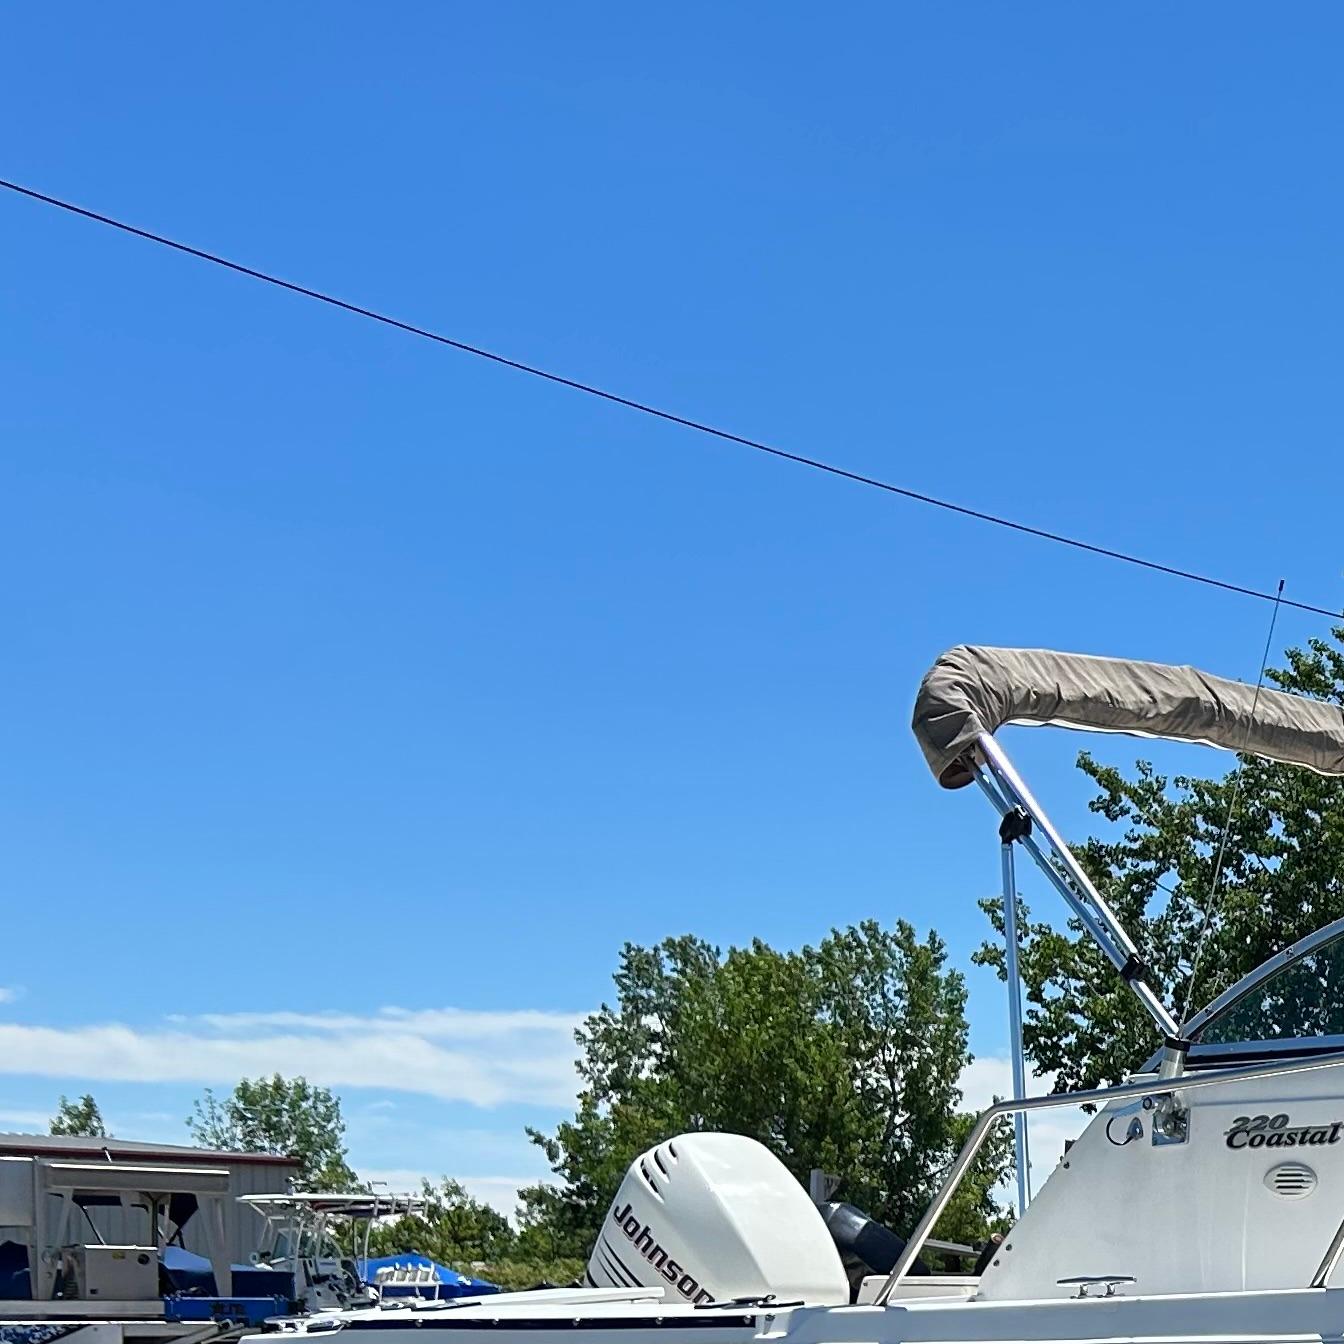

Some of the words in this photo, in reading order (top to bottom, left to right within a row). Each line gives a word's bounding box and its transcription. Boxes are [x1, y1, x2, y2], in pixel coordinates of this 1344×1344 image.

[1226, 1121, 1344, 1149] Coastal
[1229, 1113, 1290, 1132] 220
[613, 1203, 716, 1304] Johnson
